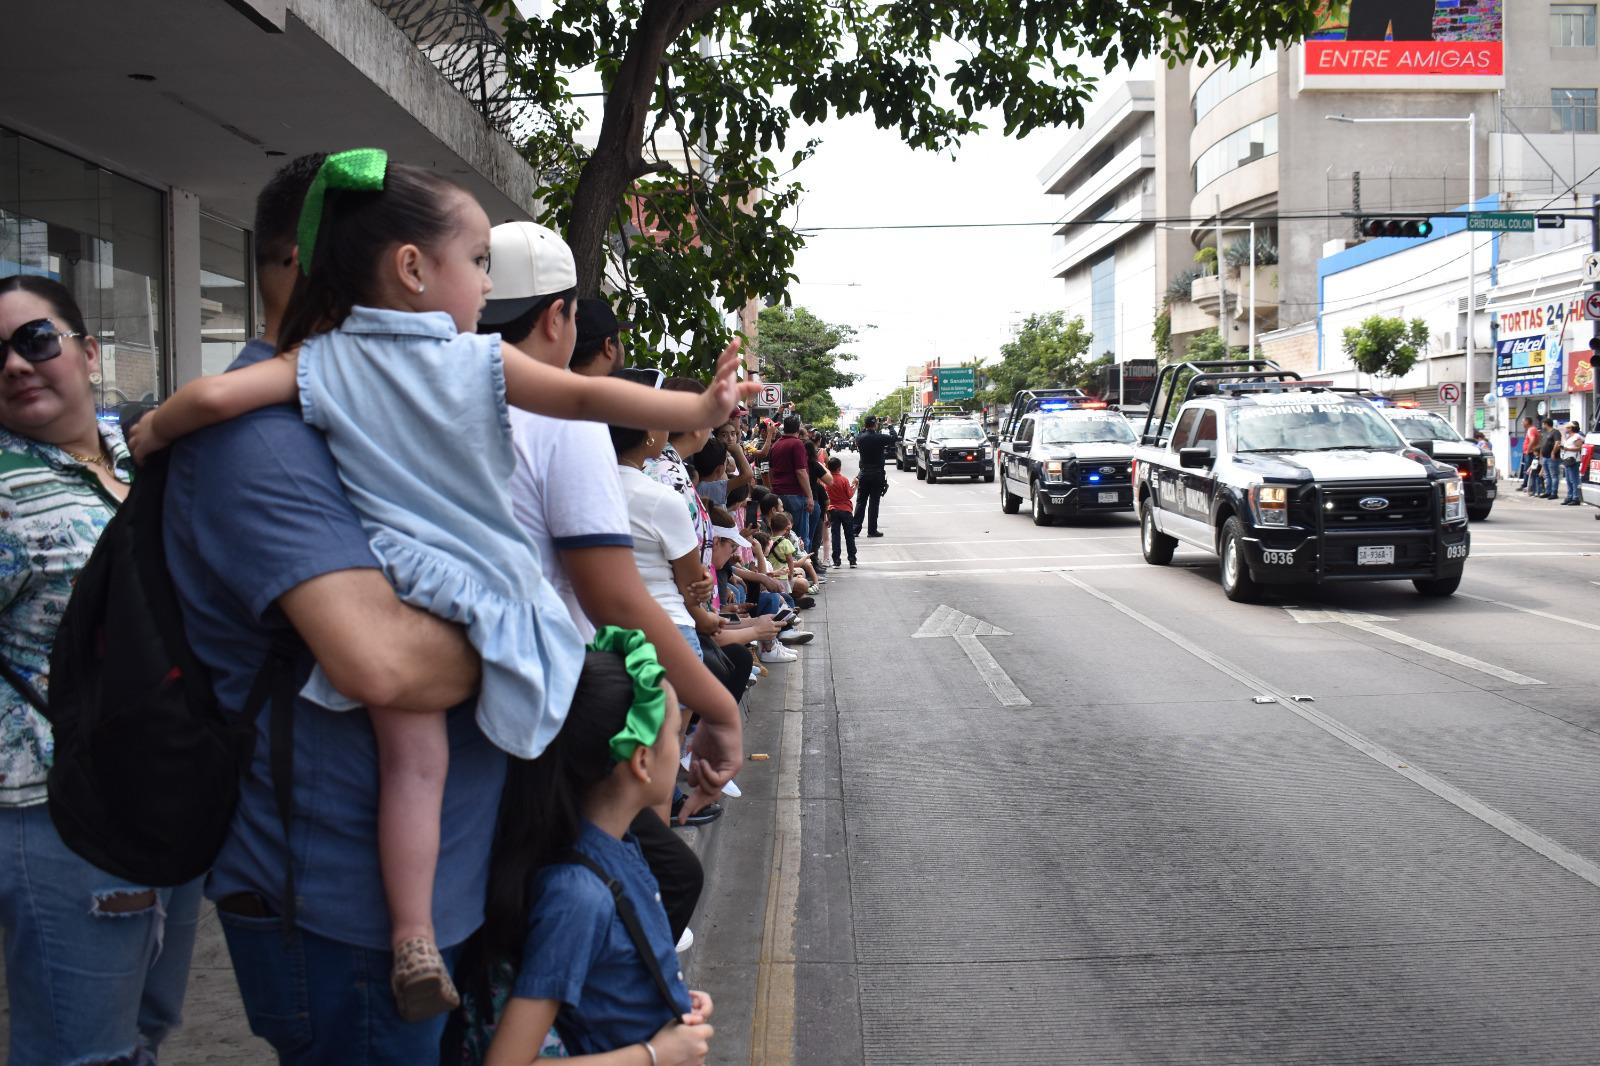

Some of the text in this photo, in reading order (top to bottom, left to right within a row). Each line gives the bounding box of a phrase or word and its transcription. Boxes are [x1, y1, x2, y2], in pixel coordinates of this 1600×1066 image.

[1319, 49, 1491, 68] ENTRE AMIGAS
[1469, 218, 1532, 229] CRISTOBAL COLON
[1500, 299, 1585, 333] TORTAS 24 HA
[1512, 336, 1545, 353] telcel
[766, 388, 774, 402] E
[1262, 551, 1294, 566] 0936
[1446, 544, 1467, 559] 0936
